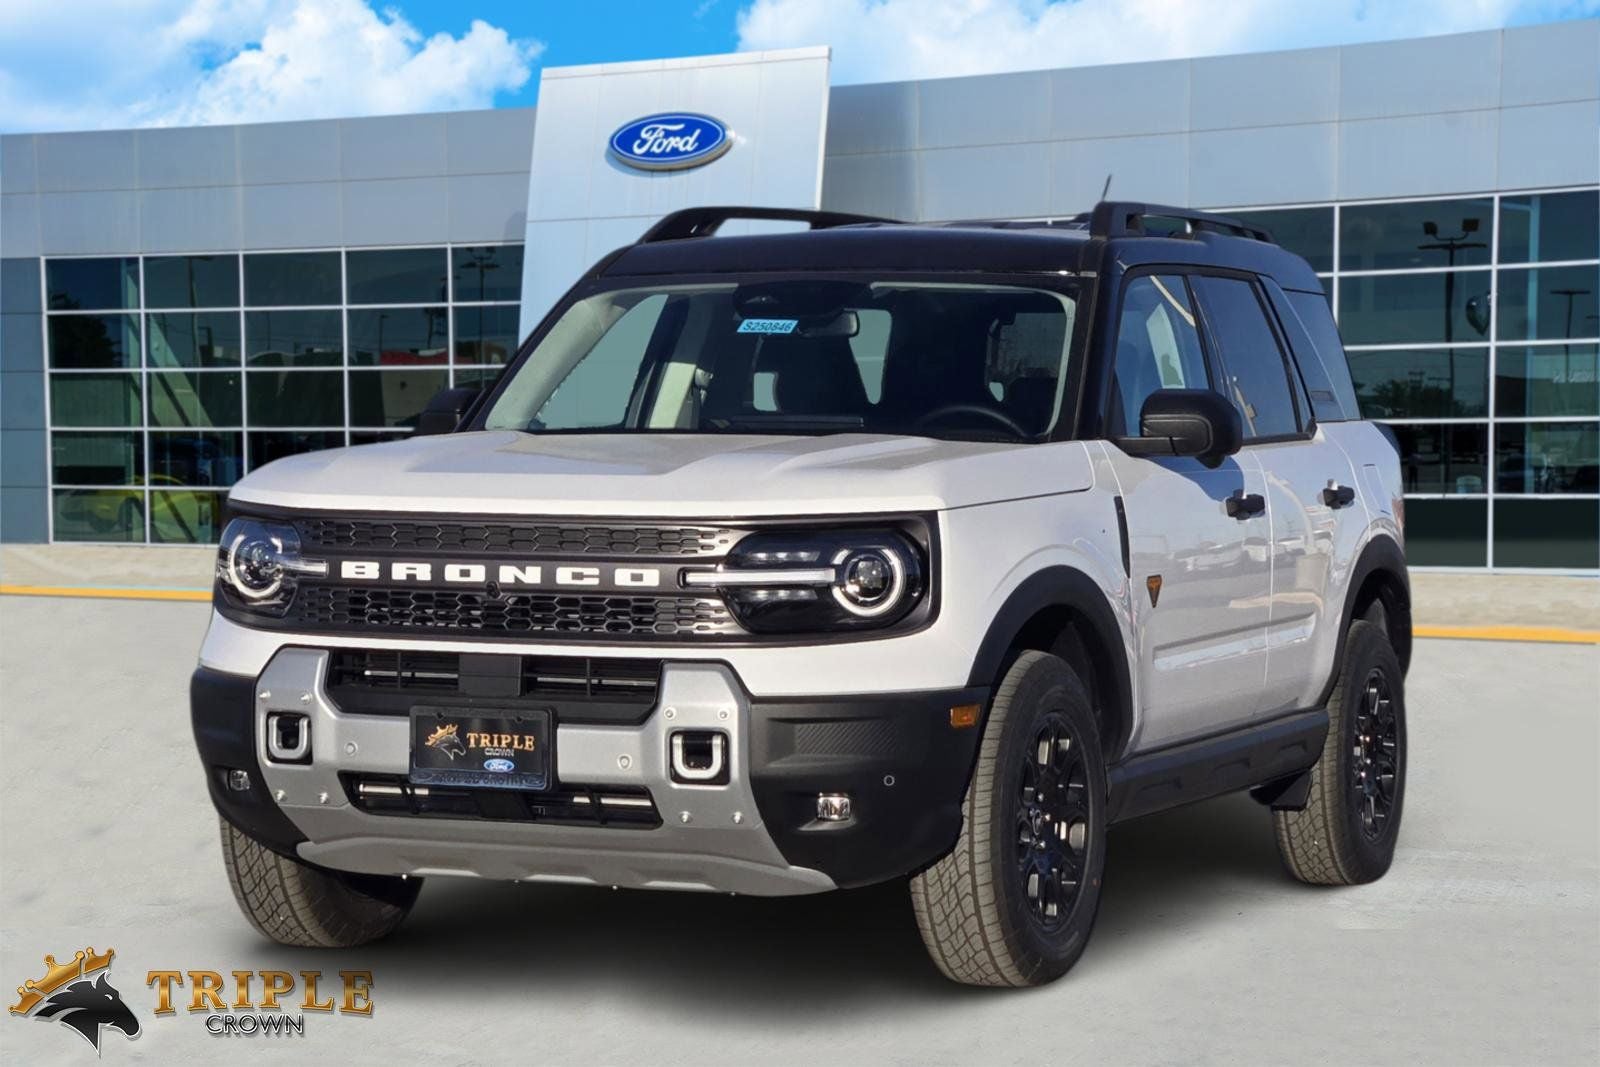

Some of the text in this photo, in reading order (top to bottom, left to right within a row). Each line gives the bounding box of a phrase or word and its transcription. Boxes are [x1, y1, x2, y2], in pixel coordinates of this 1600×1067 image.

[632, 123, 702, 155] Ford
[341, 561, 660, 587] BRONCO
[466, 732, 535, 751] TRIPLE
[484, 747, 514, 757] CROWN
